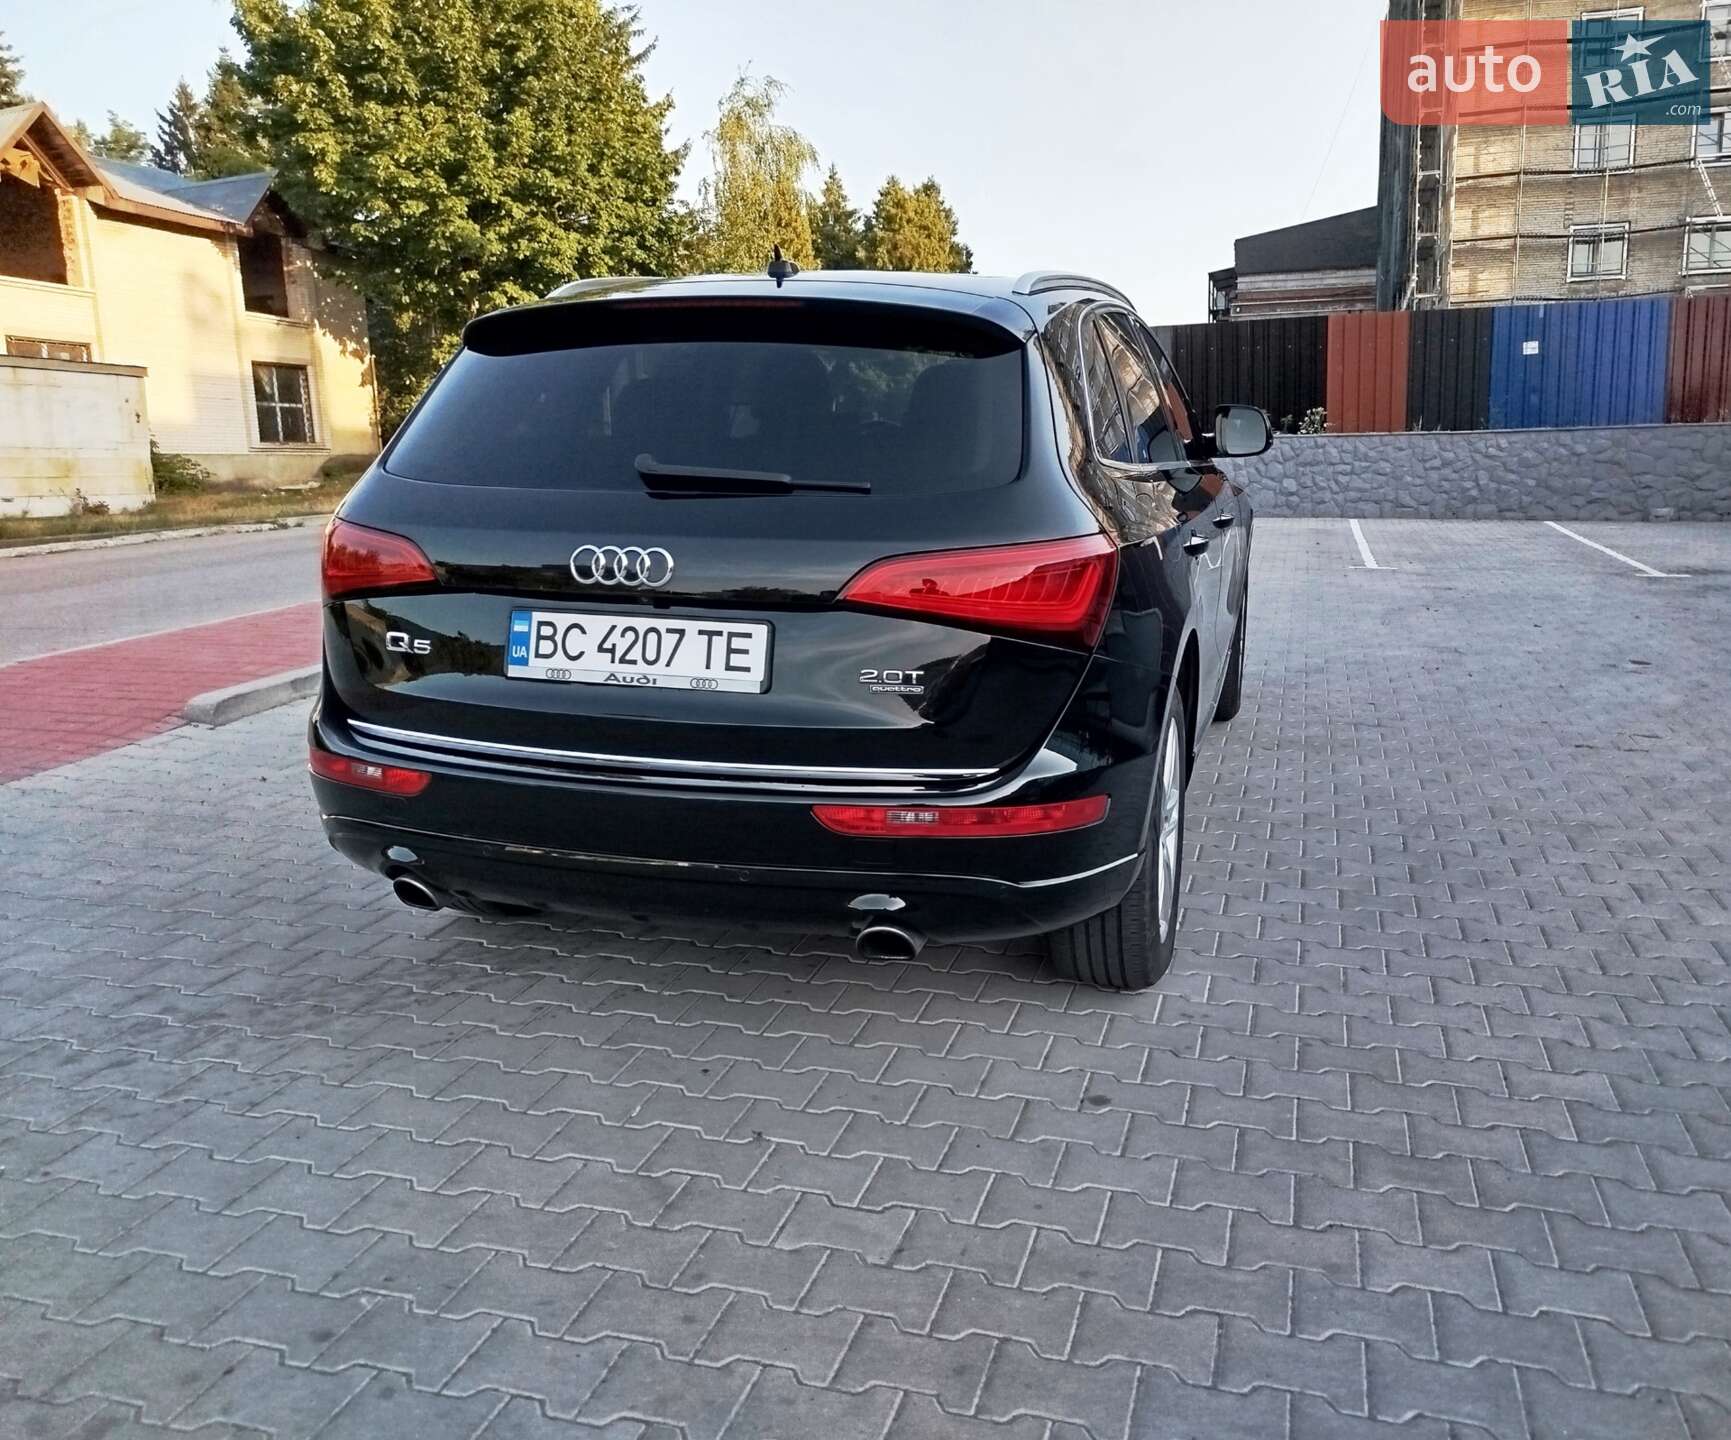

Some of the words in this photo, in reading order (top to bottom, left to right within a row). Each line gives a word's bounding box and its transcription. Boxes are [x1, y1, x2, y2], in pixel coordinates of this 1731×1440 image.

[386, 631, 431, 654] Q5
[534, 620, 587, 661] BC
[597, 624, 686, 667] 4207
[698, 629, 752, 672] TE
[512, 645, 527, 657] UA
[603, 672, 657, 685] Audi
[860, 669, 924, 684] 2.0T
